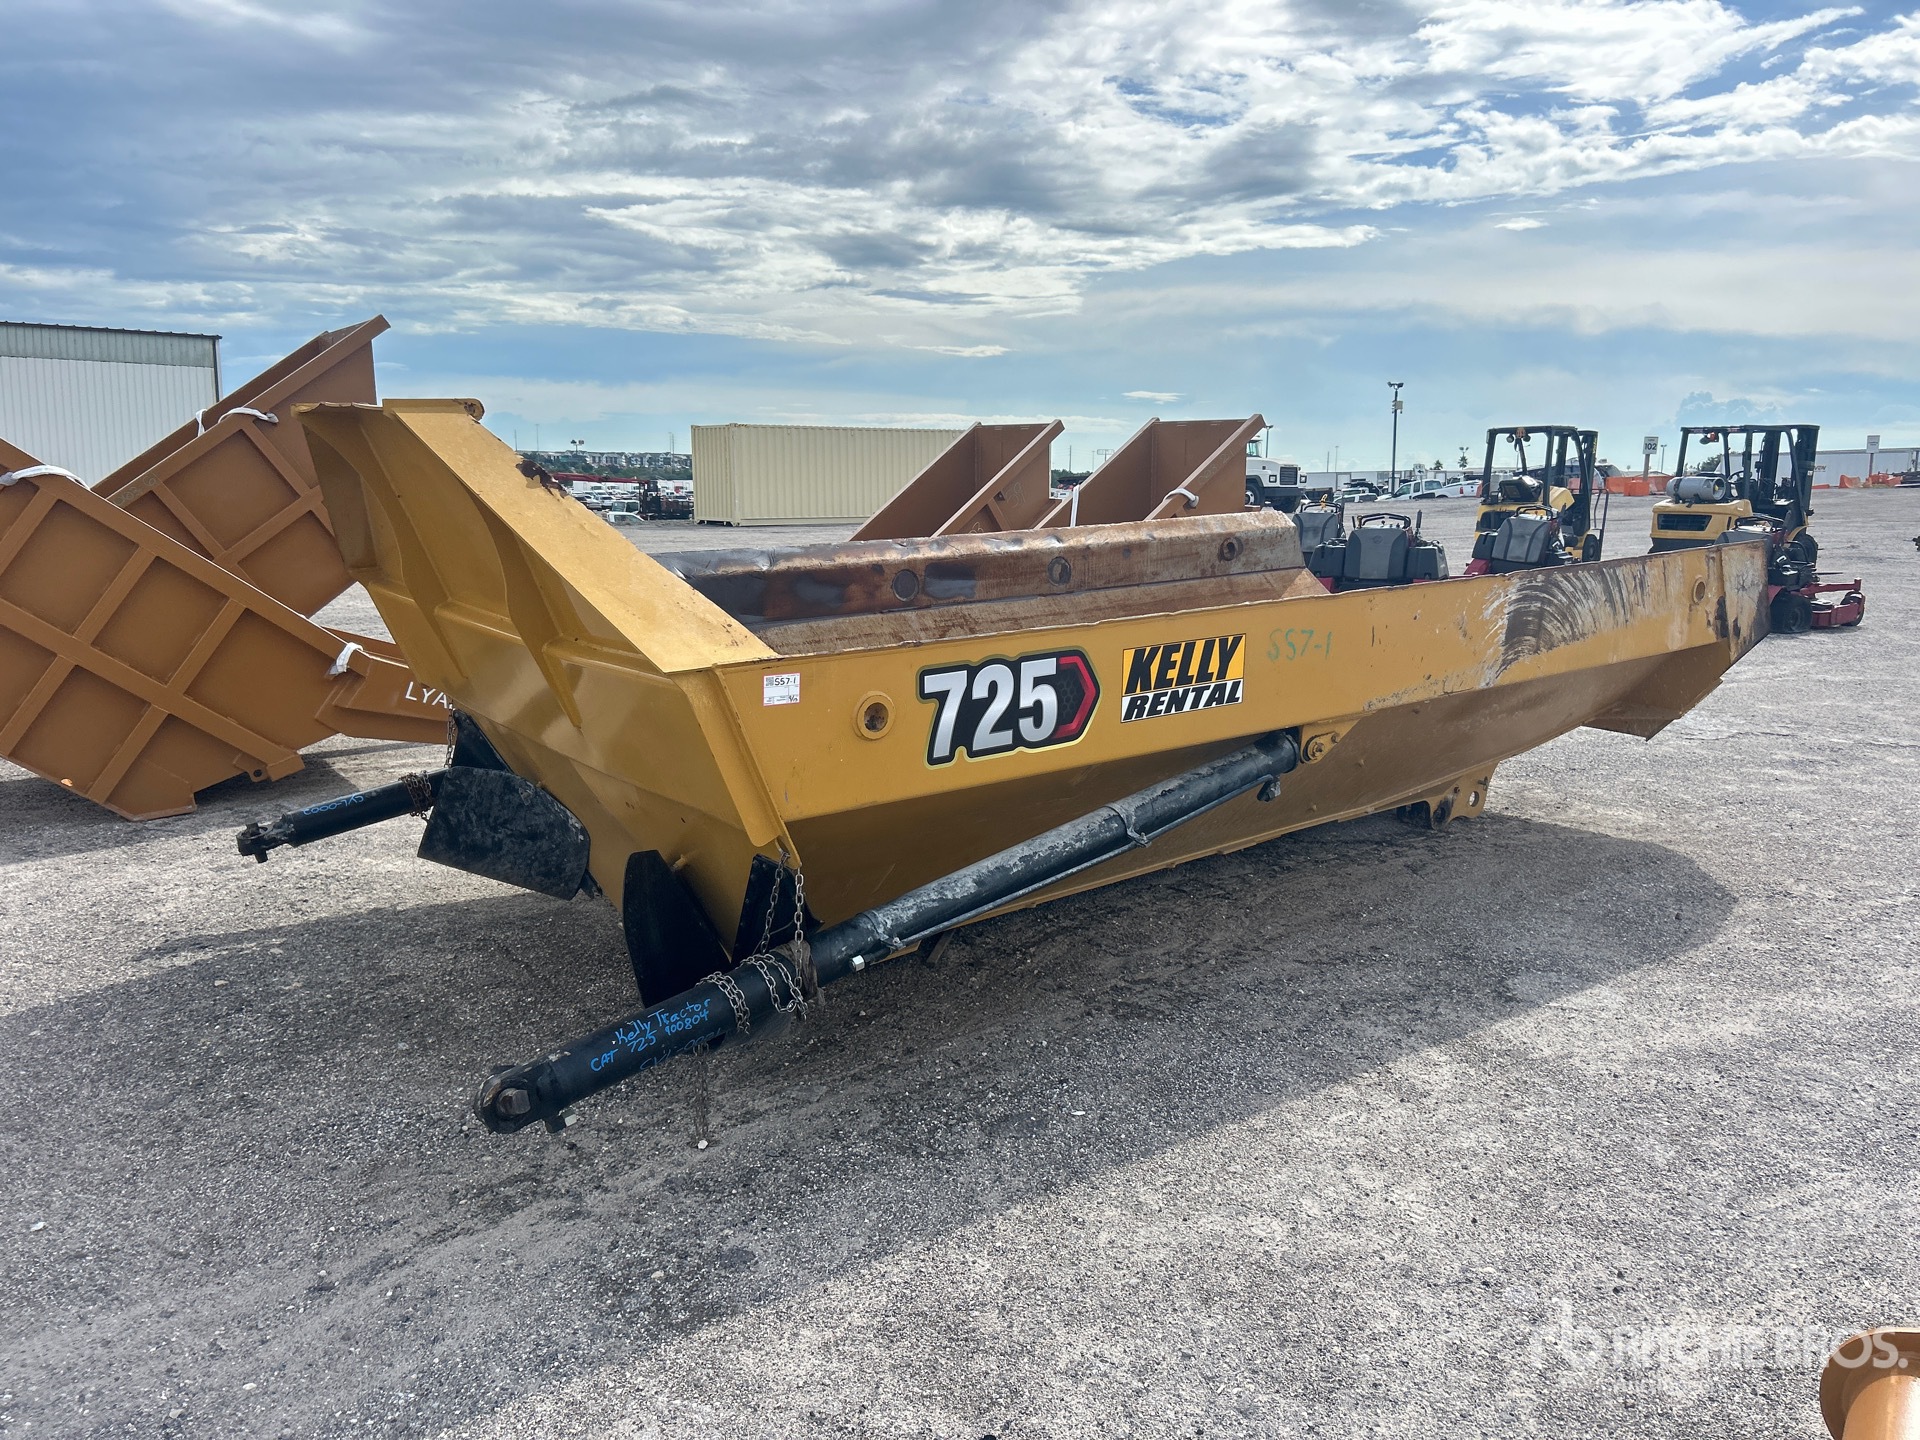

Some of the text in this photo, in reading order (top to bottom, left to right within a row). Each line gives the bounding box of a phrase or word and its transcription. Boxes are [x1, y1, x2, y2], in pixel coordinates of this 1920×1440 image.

[1644, 442, 1657, 450] 102
[1124, 636, 1243, 694] KELLY
[405, 681, 455, 710] LYA
[924, 657, 1058, 758] 725
[1123, 681, 1242, 721] RENTAL
[615, 999, 711, 1044] Kelly Tractor
[590, 1048, 618, 1072] CAT
[627, 1030, 658, 1053] 725
